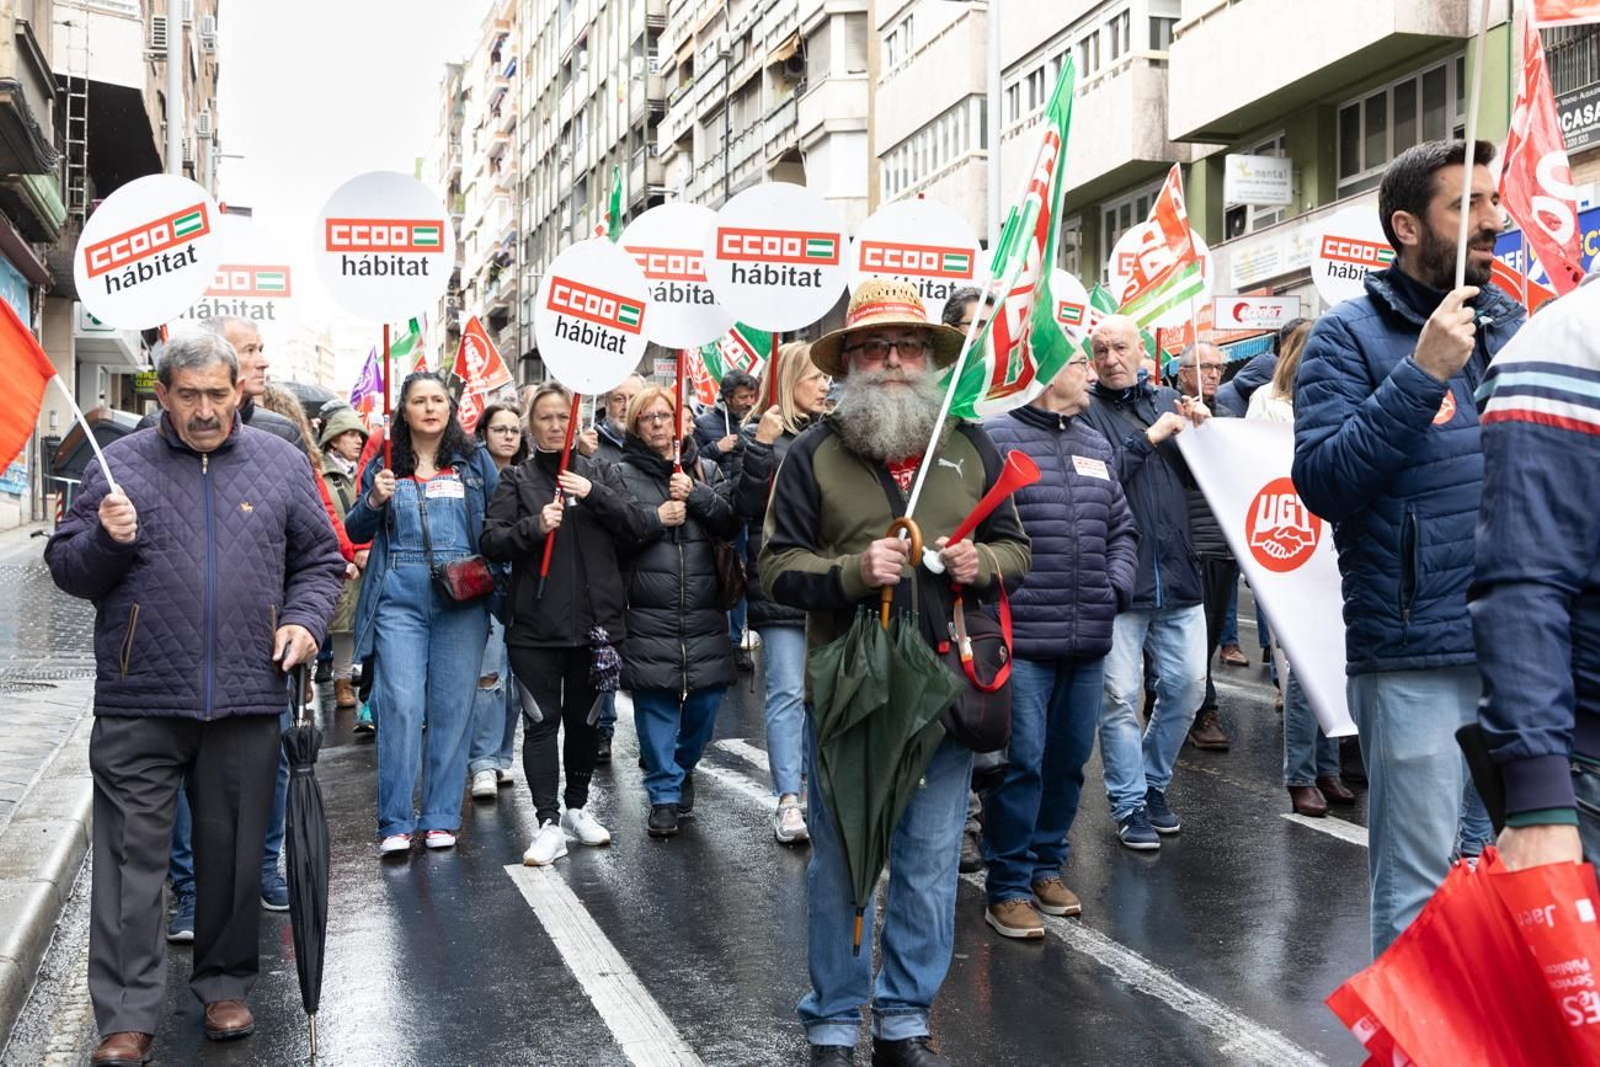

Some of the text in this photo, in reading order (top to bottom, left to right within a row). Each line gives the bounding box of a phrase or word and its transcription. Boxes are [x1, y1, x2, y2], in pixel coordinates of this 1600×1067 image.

[91, 224, 171, 271] CCOO
[331, 225, 408, 246] CCOO
[722, 234, 802, 257] CCOO
[865, 247, 939, 271] CCOO
[1324, 240, 1376, 261] CCOO
[105, 244, 198, 294] hábitat
[342, 254, 429, 276] hábitat
[731, 262, 822, 288] hábitat
[552, 284, 617, 320] CCOO
[648, 281, 721, 305] ábita
[555, 315, 627, 354] hábitat
[1255, 493, 1310, 532] UGT
